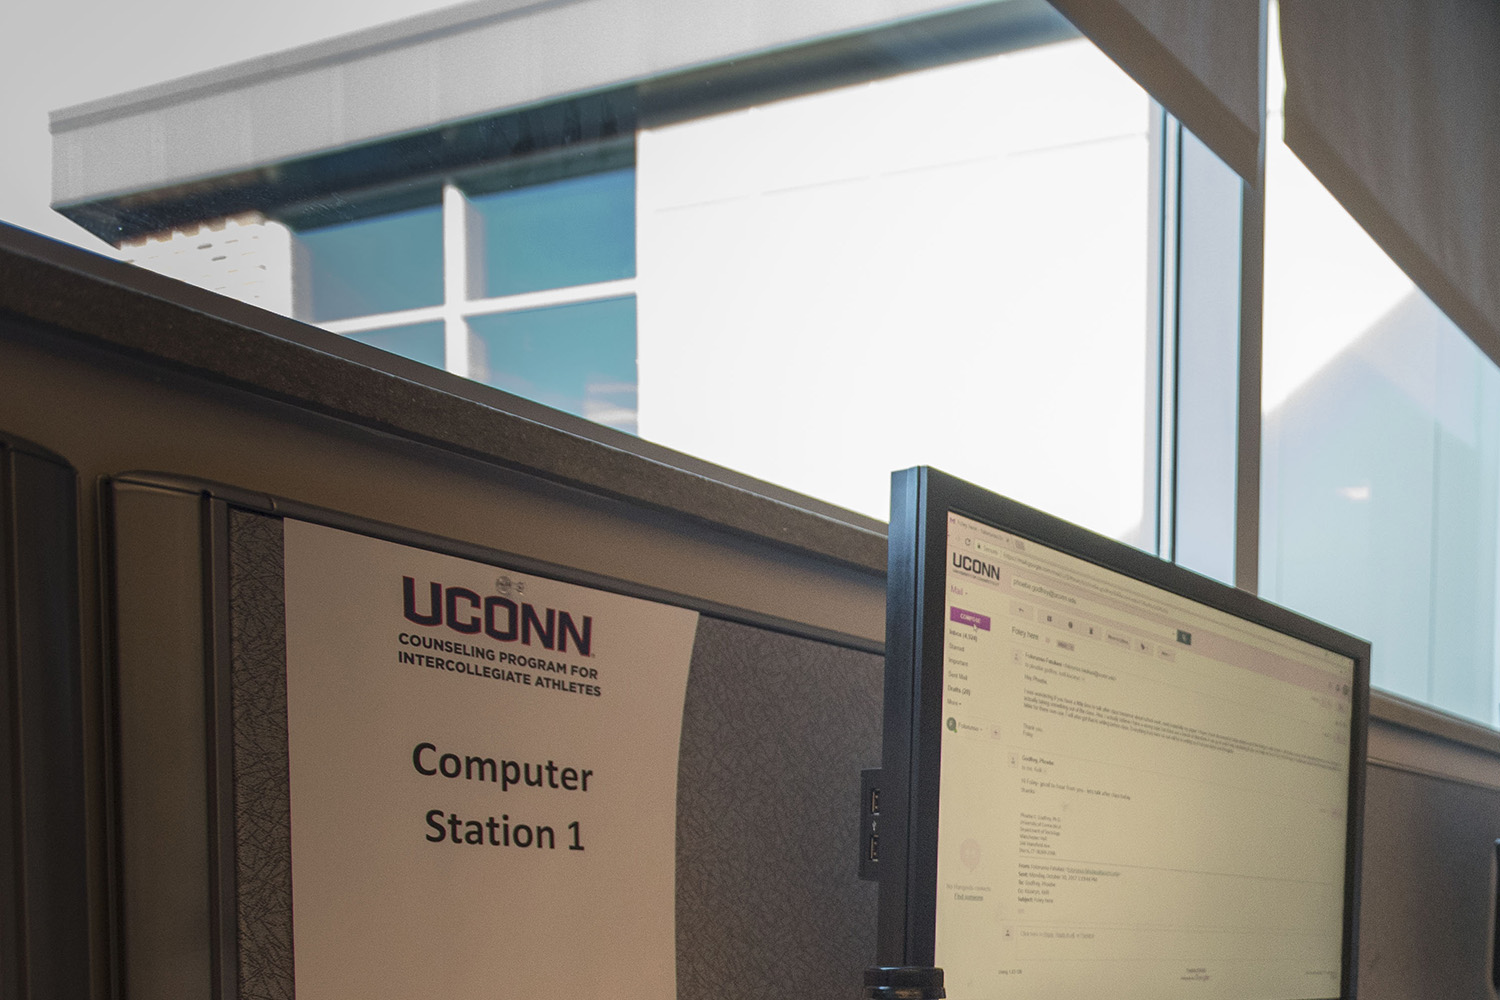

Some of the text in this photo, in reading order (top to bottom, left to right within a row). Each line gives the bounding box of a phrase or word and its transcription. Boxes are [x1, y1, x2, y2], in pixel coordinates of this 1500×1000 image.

[952, 552, 999, 580] UCONN
[950, 584, 963, 596] Mail
[403, 576, 592, 657] UCONN
[960, 612, 981, 625] COMPOSE
[1011, 625, 1038, 641] Foley here
[399, 633, 598, 680] COUNSELING PROGRAM FOR
[948, 657, 968, 667] Important
[399, 651, 601, 696] INTERCOLLEGIATE ATHLETES
[948, 670, 957, 678] Sent
[947, 684, 960, 694] Drafts
[413, 742, 593, 791] Computer
[425, 810, 585, 850] Station 1
